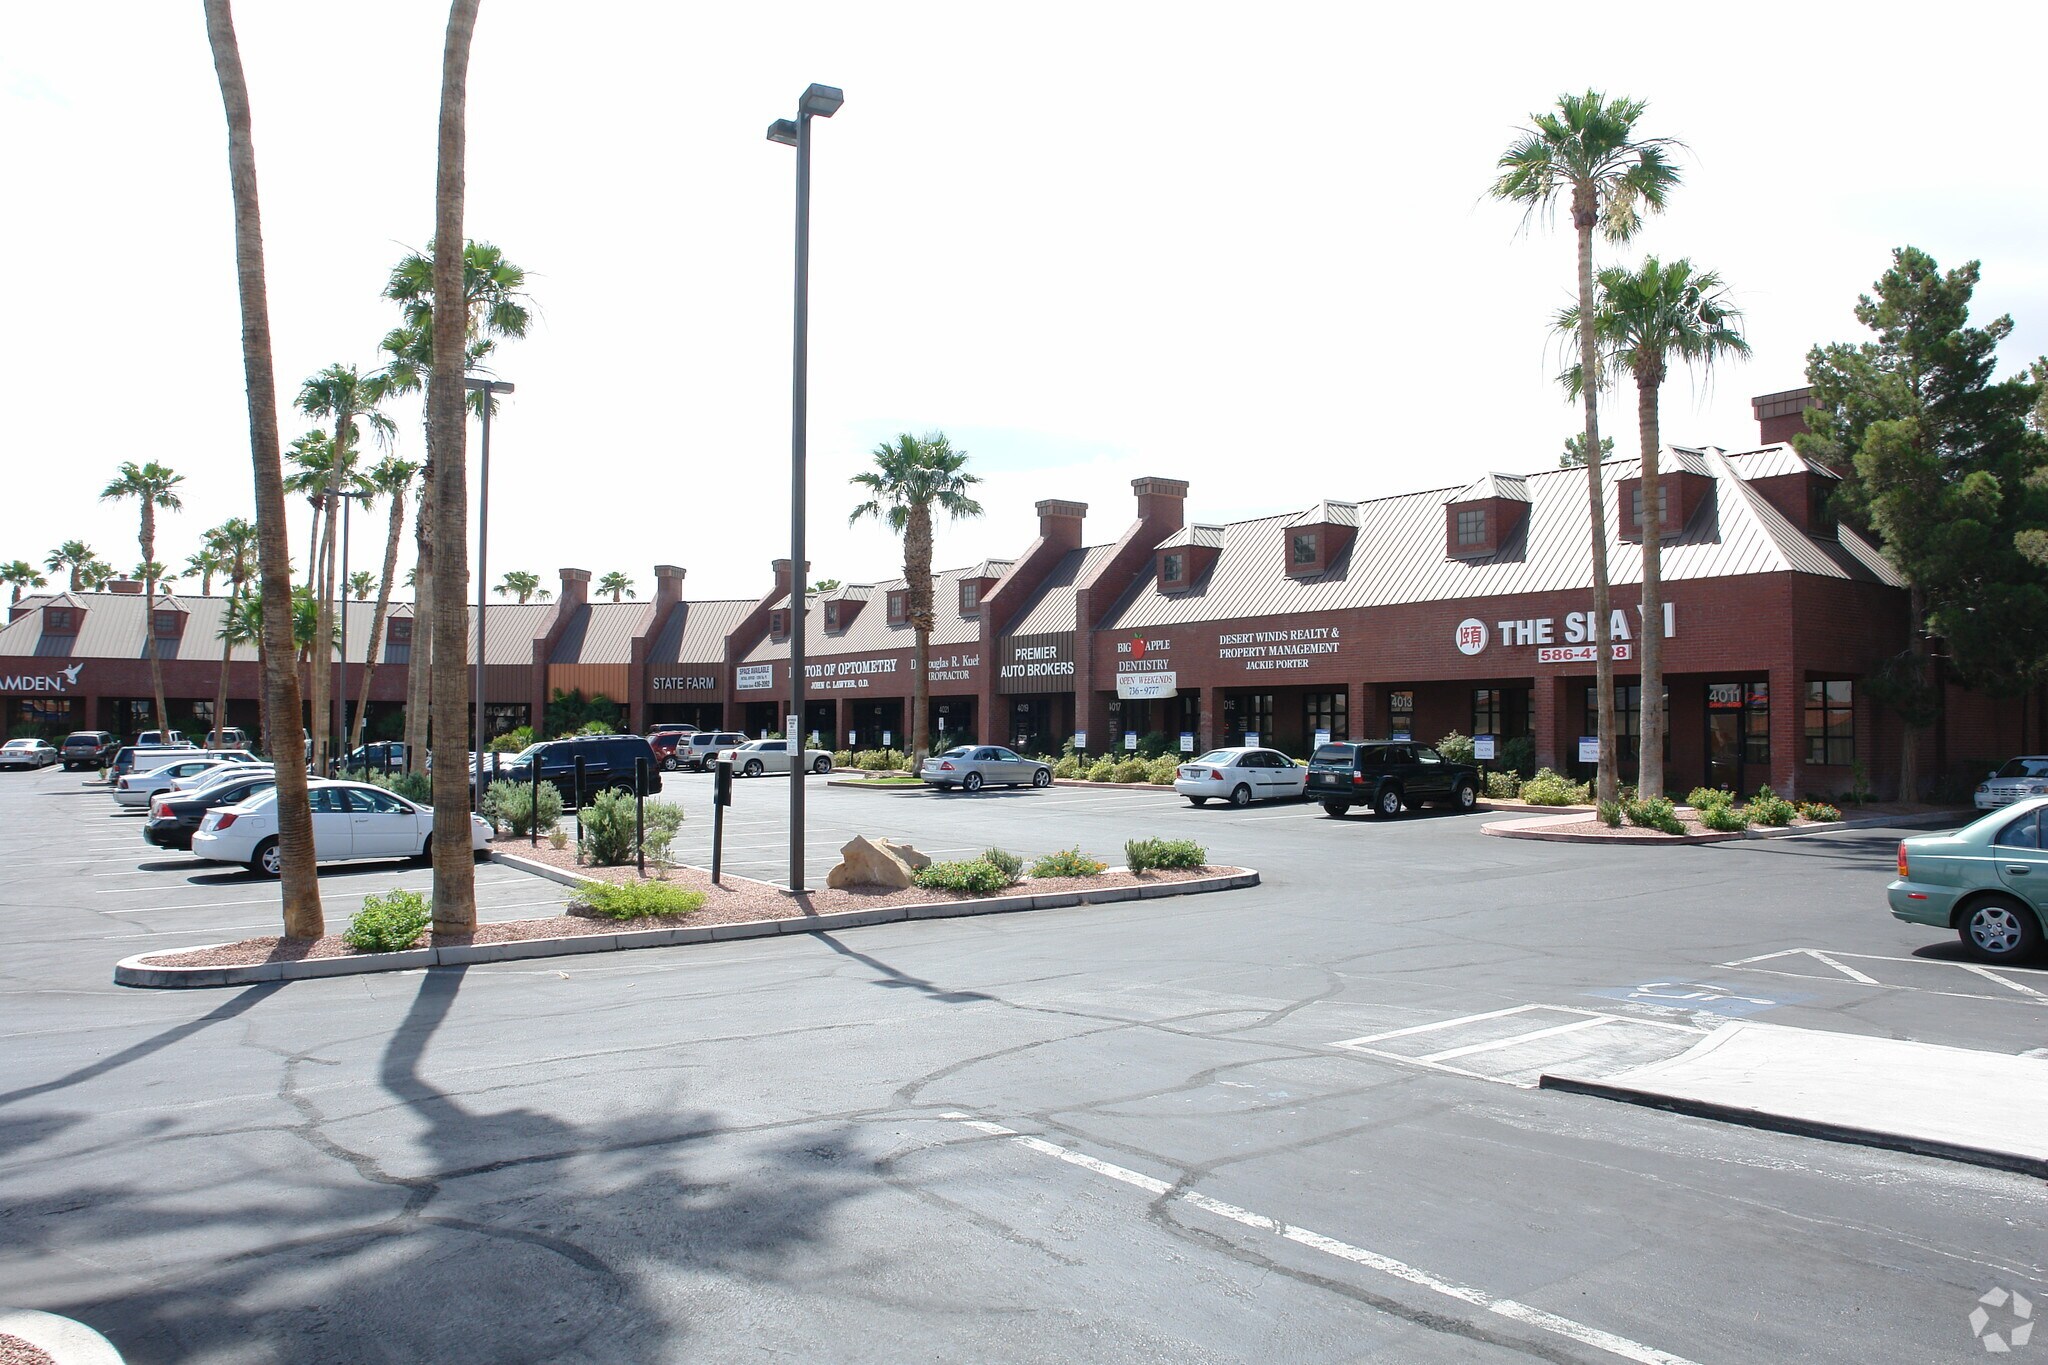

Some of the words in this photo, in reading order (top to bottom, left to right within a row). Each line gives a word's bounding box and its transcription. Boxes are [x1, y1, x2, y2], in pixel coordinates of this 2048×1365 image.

[1498, 618, 1554, 646] THE
[1637, 602, 1676, 638] I
[1220, 632, 1254, 645] DESERT
[1256, 631, 1287, 643] WINDS
[1290, 628, 1329, 640] REALTY
[1331, 627, 1339, 638] &
[1117, 642, 1132, 653] BIG
[1145, 640, 1170, 651] APPLE
[1220, 646, 1266, 659] PROPERTY
[1269, 643, 1339, 656] MANAGEMENT
[1540, 646, 1627, 660] 586-48
[1015, 646, 1057, 661] PREMIER
[824, 663, 836, 676] OF
[838, 659, 898, 675] OPTOMETRY
[951, 655, 960, 667] R.
[1119, 659, 1169, 671] DENTISTRY
[1246, 660, 1274, 670] JACKIE
[1276, 659, 1309, 669] PORTER
[1001, 664, 1026, 678] AUTO
[1027, 662, 1075, 676] BROKERS
[653, 677, 684, 690] STATE
[687, 677, 715, 689] FARM
[811, 681, 824, 689] JOHN
[1119, 676, 1136, 685] OPEN
[1138, 675, 1173, 684] WEEKENDS
[1391, 696, 1413, 707] 4013
[1709, 689, 1740, 702] 4011
